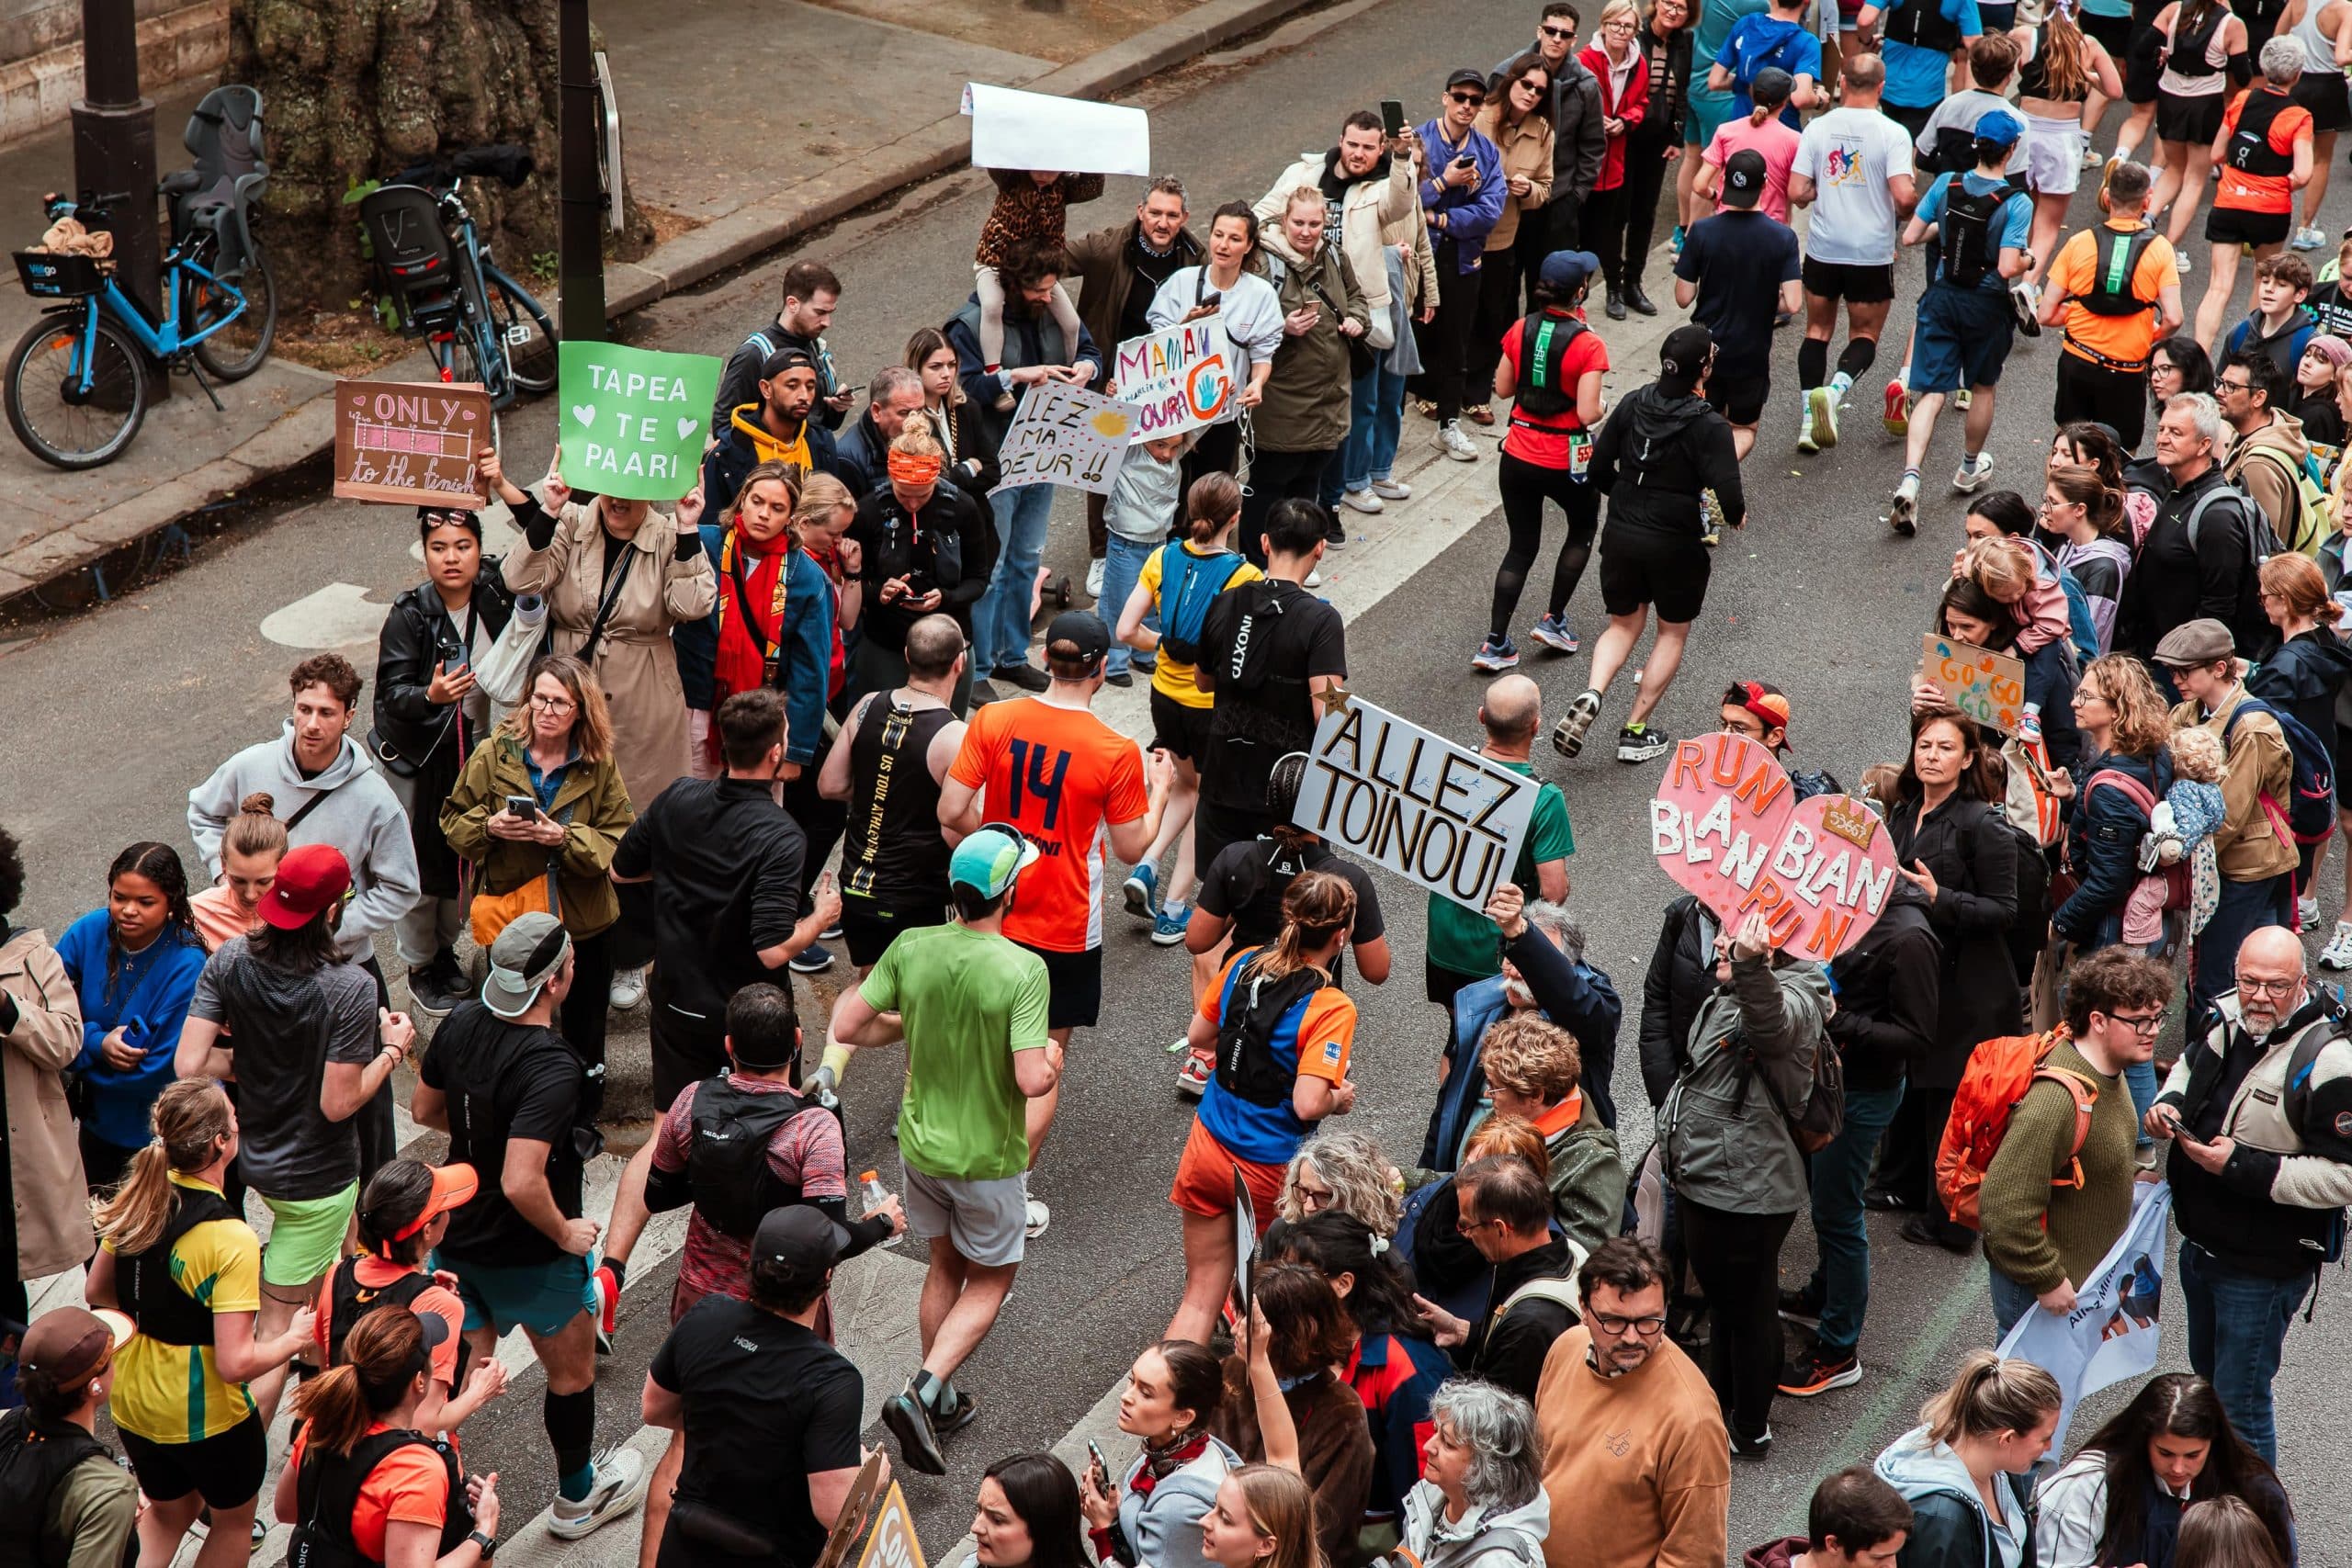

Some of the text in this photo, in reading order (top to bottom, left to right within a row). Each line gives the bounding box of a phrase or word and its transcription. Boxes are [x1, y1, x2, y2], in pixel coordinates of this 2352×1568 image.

[1119, 325, 1211, 387] MAMAN
[587, 364, 688, 402] TAPEA
[348, 411, 361, 421] 42
[374, 393, 460, 426] ONLY
[616, 412, 659, 443] TE
[1014, 392, 1091, 429] LEZ
[1020, 427, 1057, 446] MA
[349, 452, 476, 494] to the finish
[584, 442, 678, 479] PAARI
[1000, 450, 1074, 478] OEUR
[1940, 658, 2021, 705] GO GO
[1958, 691, 1992, 721] GO
[879, 753, 894, 773] US
[1319, 706, 1521, 844] ALLEZ
[1673, 734, 1787, 817] RUN
[874, 773, 890, 801] TOUL
[1009, 738, 1072, 831] 14
[1649, 793, 1770, 891] BLAN
[1771, 819, 1894, 917] BLAN
[1736, 874, 1855, 964] RUN
[1229, 1038, 1243, 1072] KIPRUN
[2068, 1299, 2104, 1330] Allez
[733, 1335, 759, 1353] HOKA
